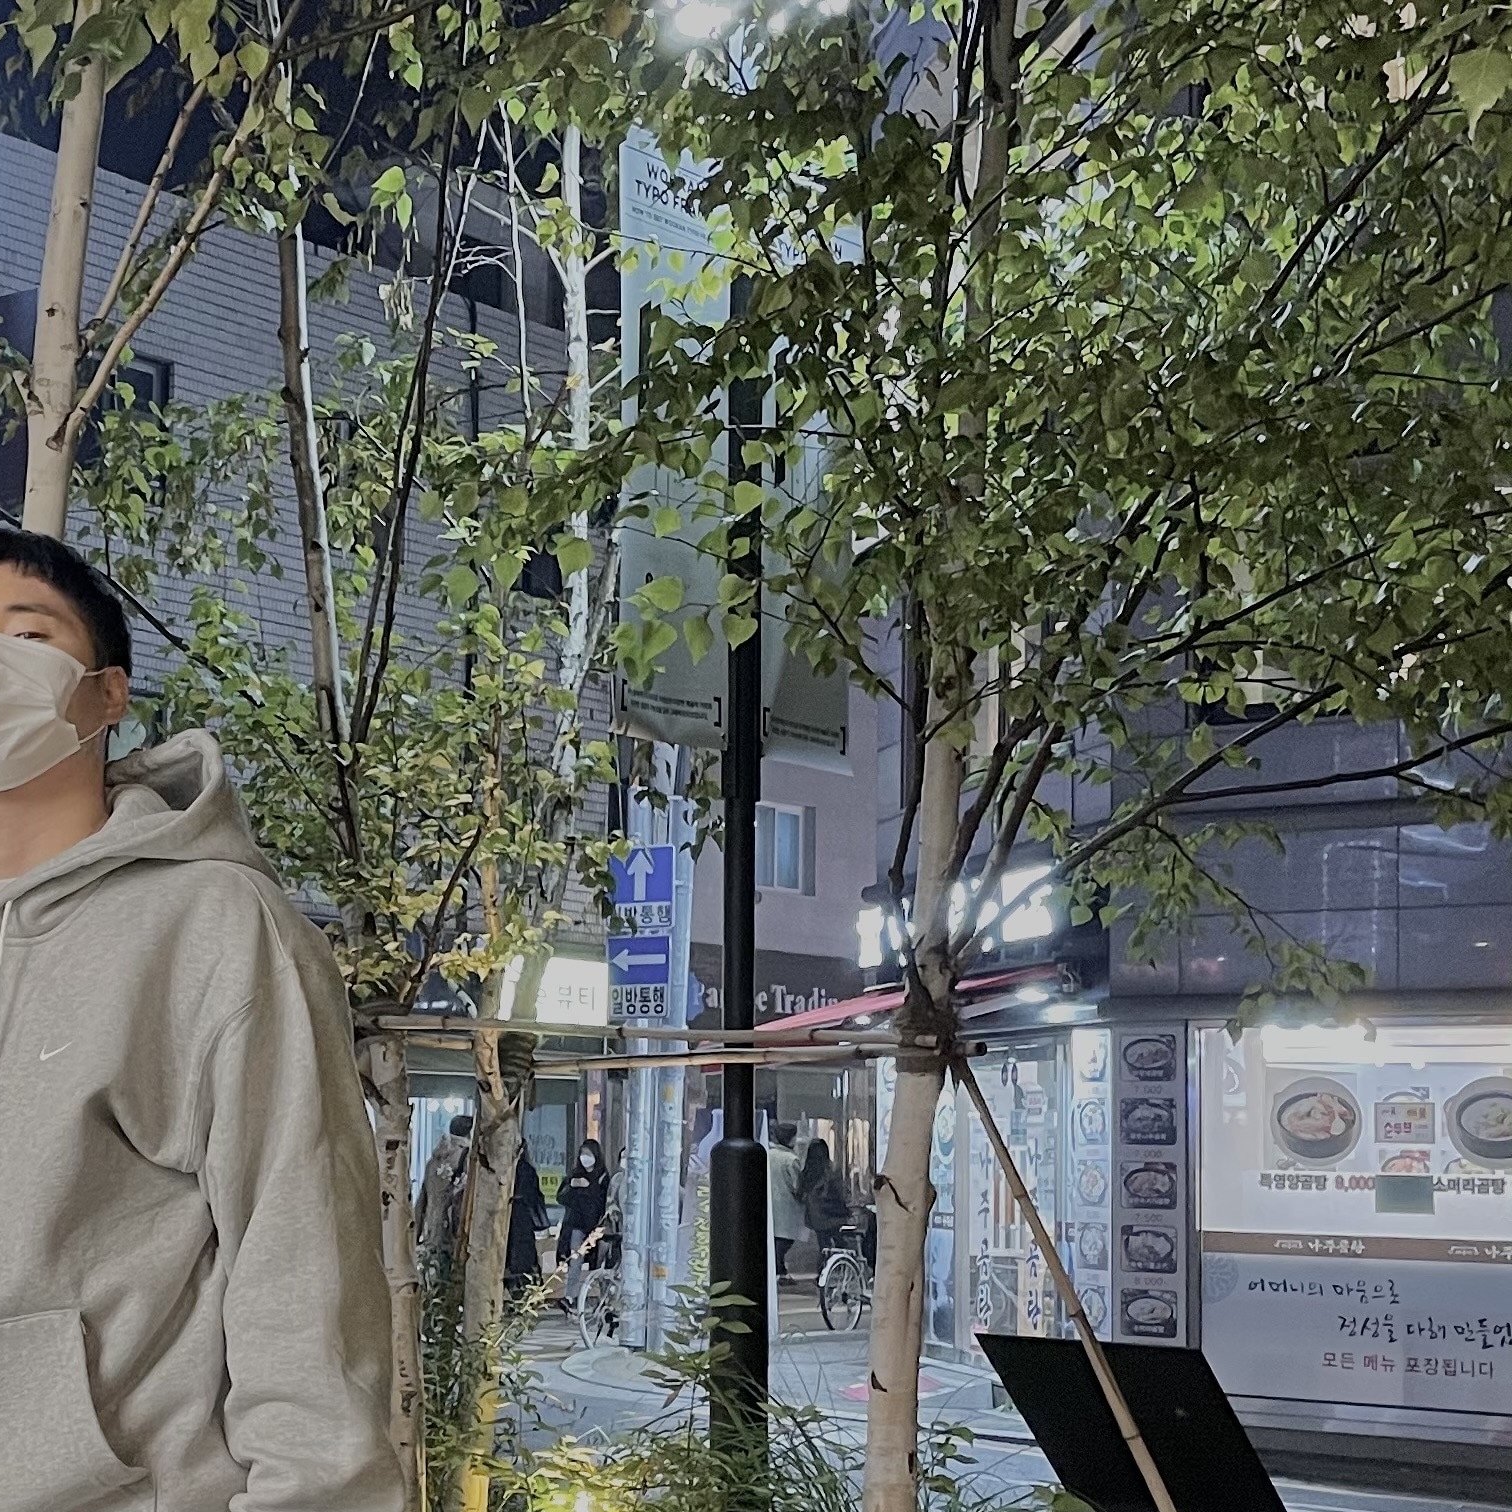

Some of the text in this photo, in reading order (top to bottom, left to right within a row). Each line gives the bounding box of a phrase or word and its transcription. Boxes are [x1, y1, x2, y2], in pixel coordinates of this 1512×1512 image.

[617, 904, 672, 926] 방통행
[611, 986, 665, 1015] 일방통행
[1248, 1278, 1400, 1304] 어머니의 마음으로
[1338, 1313, 1397, 1343] 정성을
[1407, 1316, 1446, 1340] 다해
[1322, 1352, 1494, 1379] 모든 메뉴 포장됩니다
